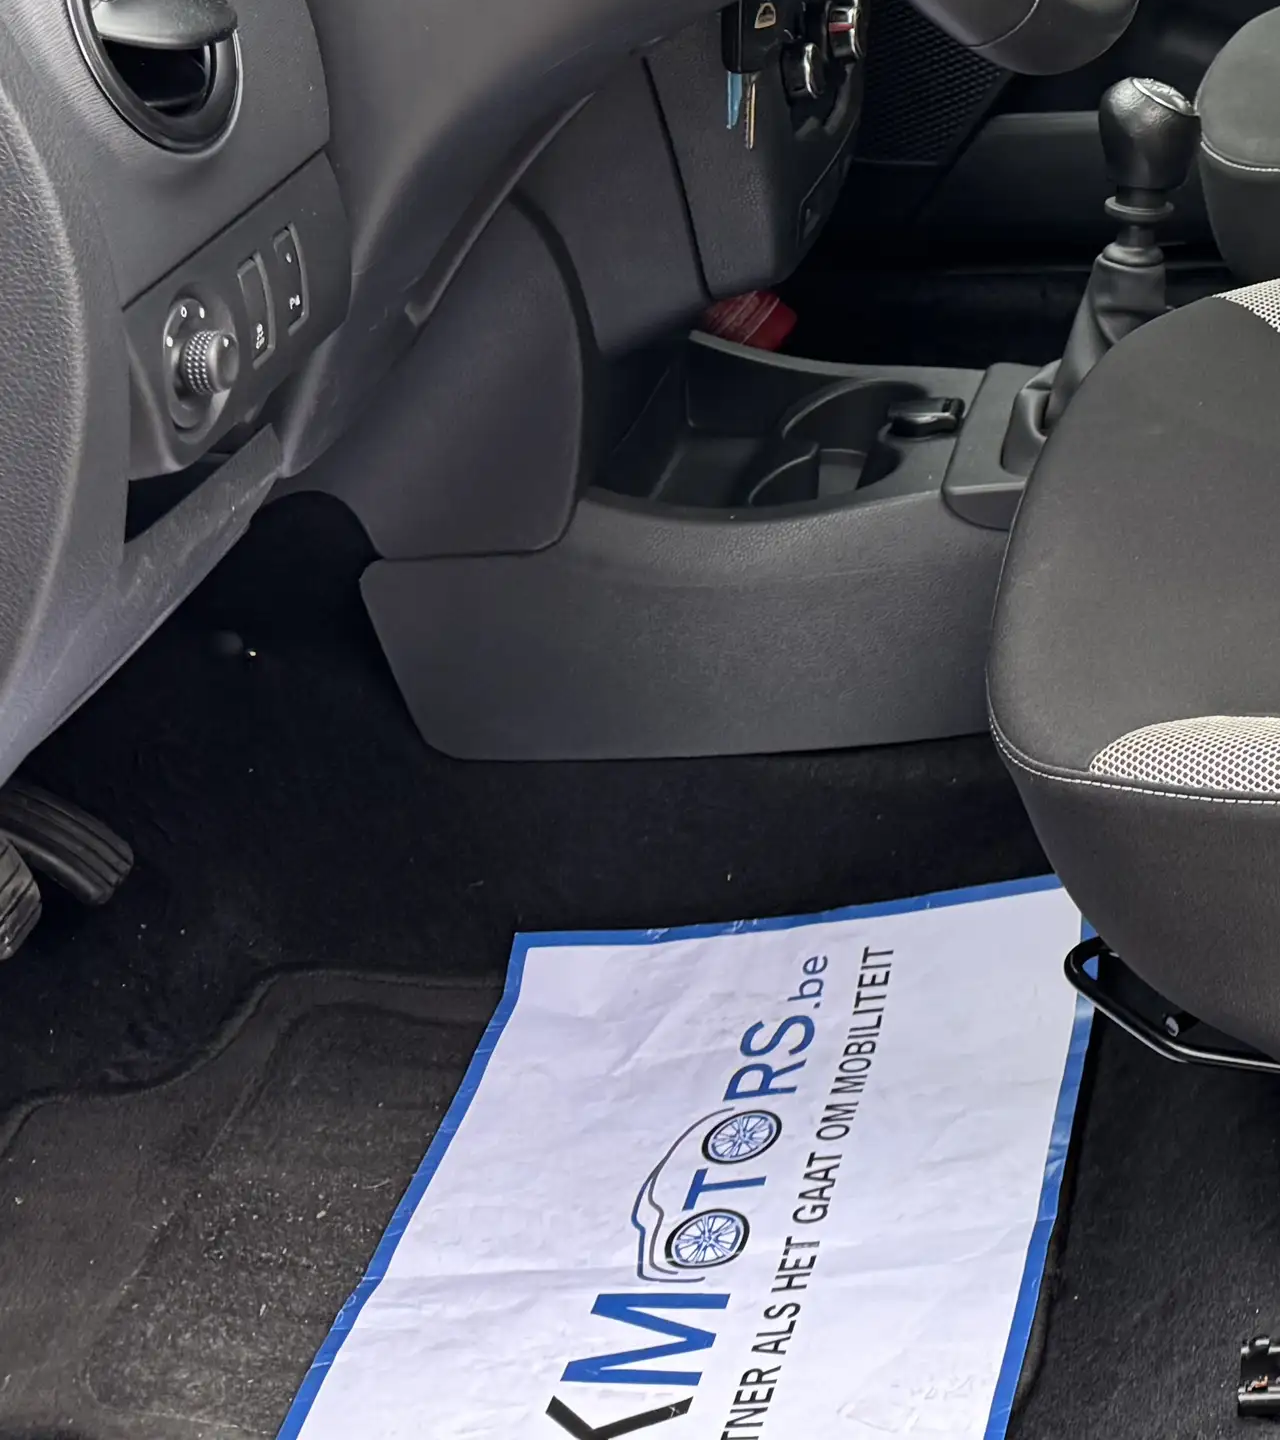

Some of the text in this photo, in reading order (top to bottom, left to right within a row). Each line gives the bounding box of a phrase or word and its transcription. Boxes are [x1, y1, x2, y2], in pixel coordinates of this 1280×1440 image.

[829, 946, 894, 1096] MOBILITEIT
[815, 1101, 859, 1141] OM
[792, 1151, 842, 1224] GAAT
[771, 1236, 820, 1293] HET
[751, 1302, 801, 1356] ALS
